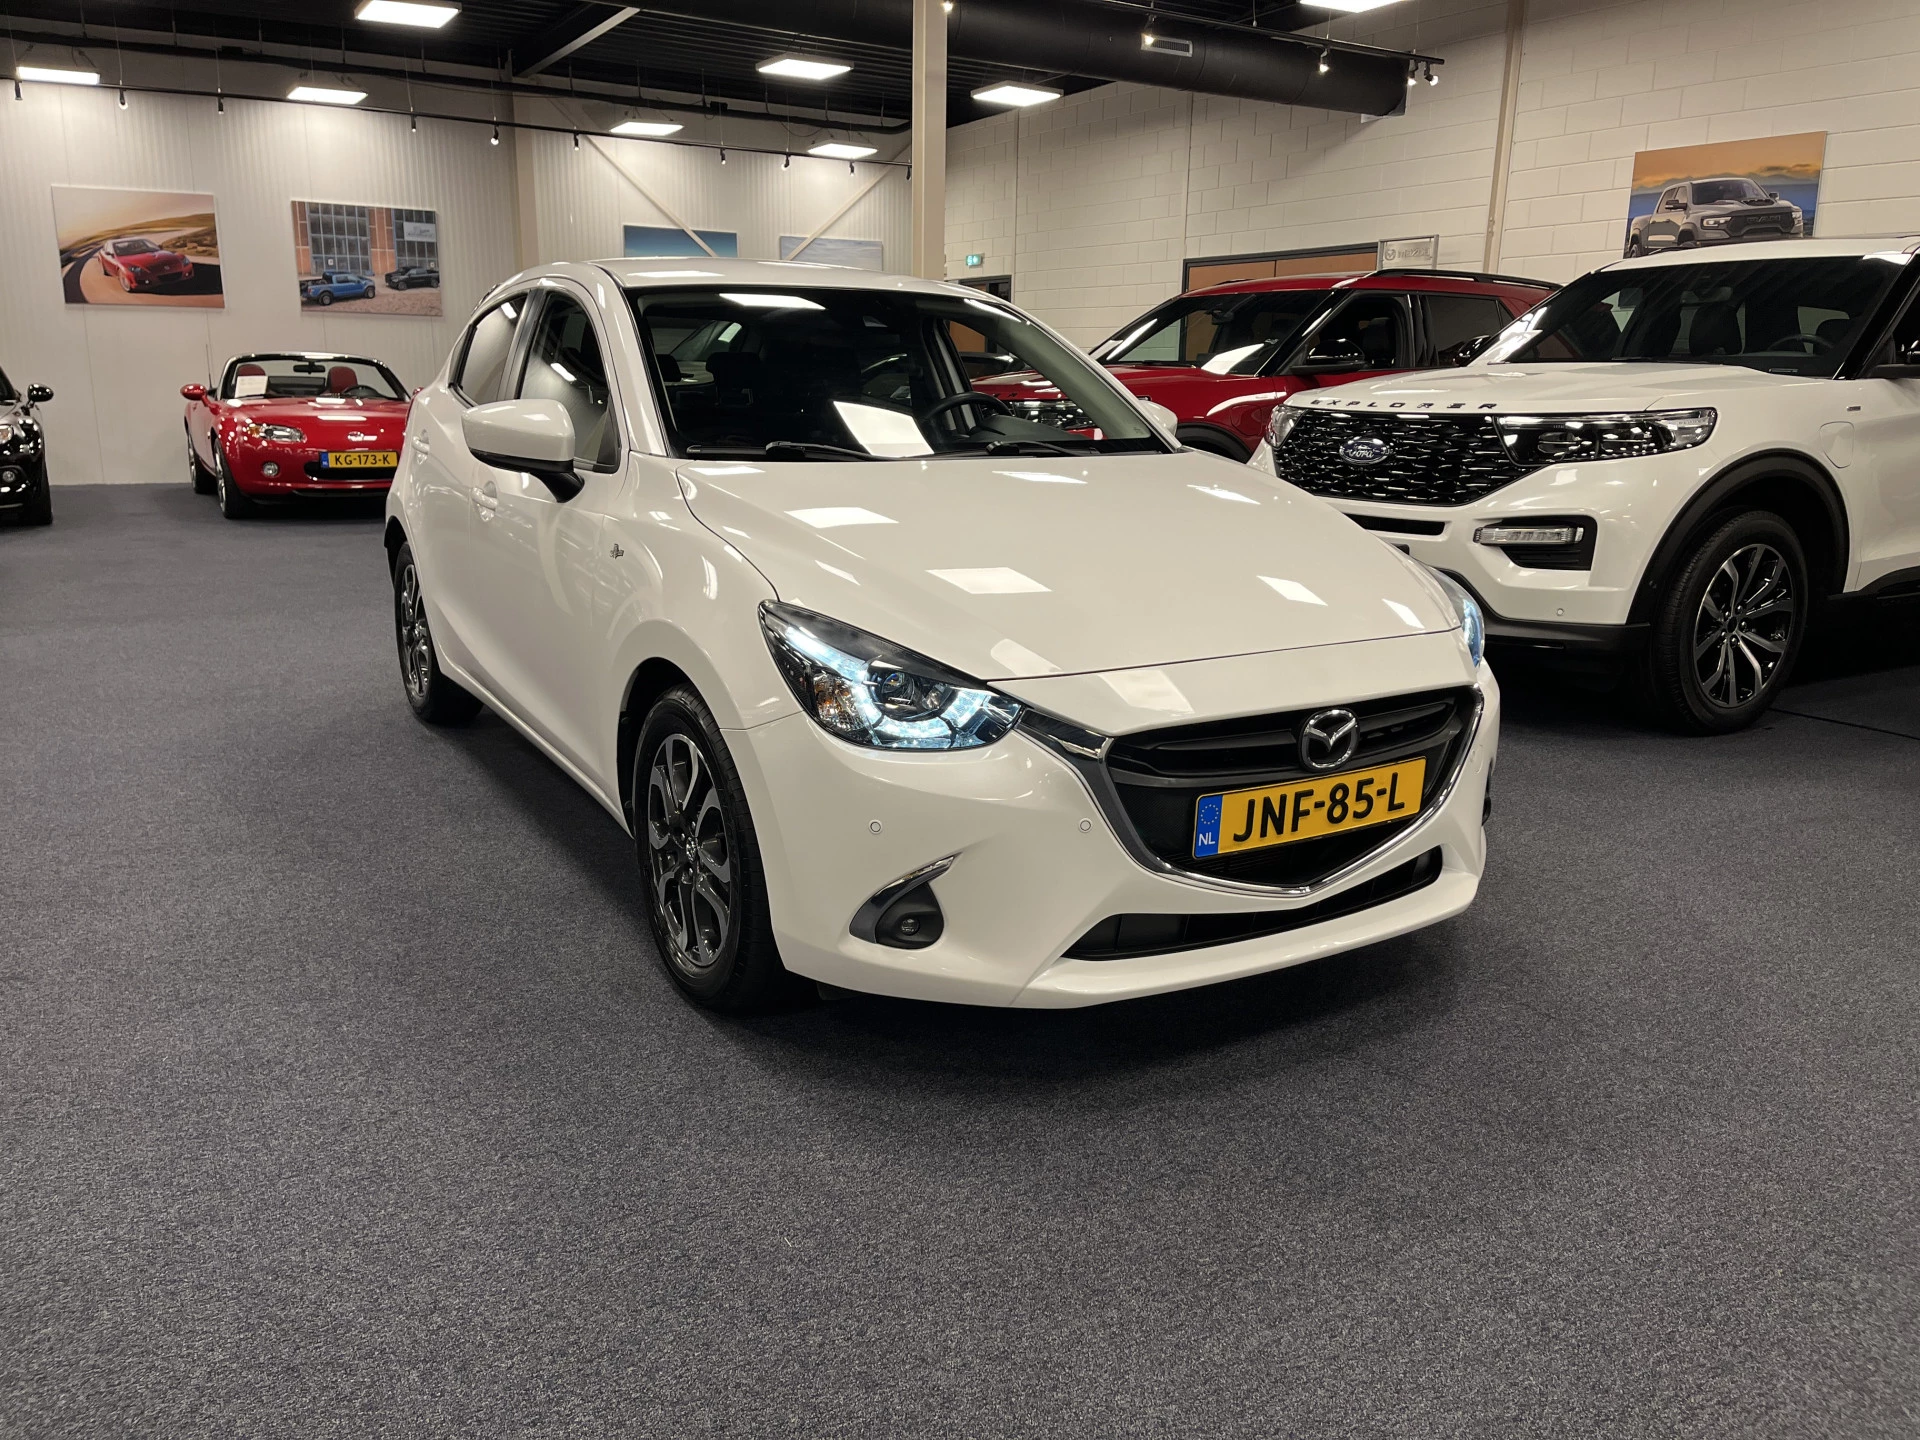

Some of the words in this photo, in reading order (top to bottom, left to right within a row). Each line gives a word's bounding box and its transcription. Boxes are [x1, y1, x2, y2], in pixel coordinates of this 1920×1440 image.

[1310, 399, 1498, 409] EXPLORER
[1345, 443, 1381, 459] Ford
[334, 454, 390, 466] KG-173-K
[1233, 772, 1405, 843] JNF-85-L
[1198, 832, 1216, 847] NL
